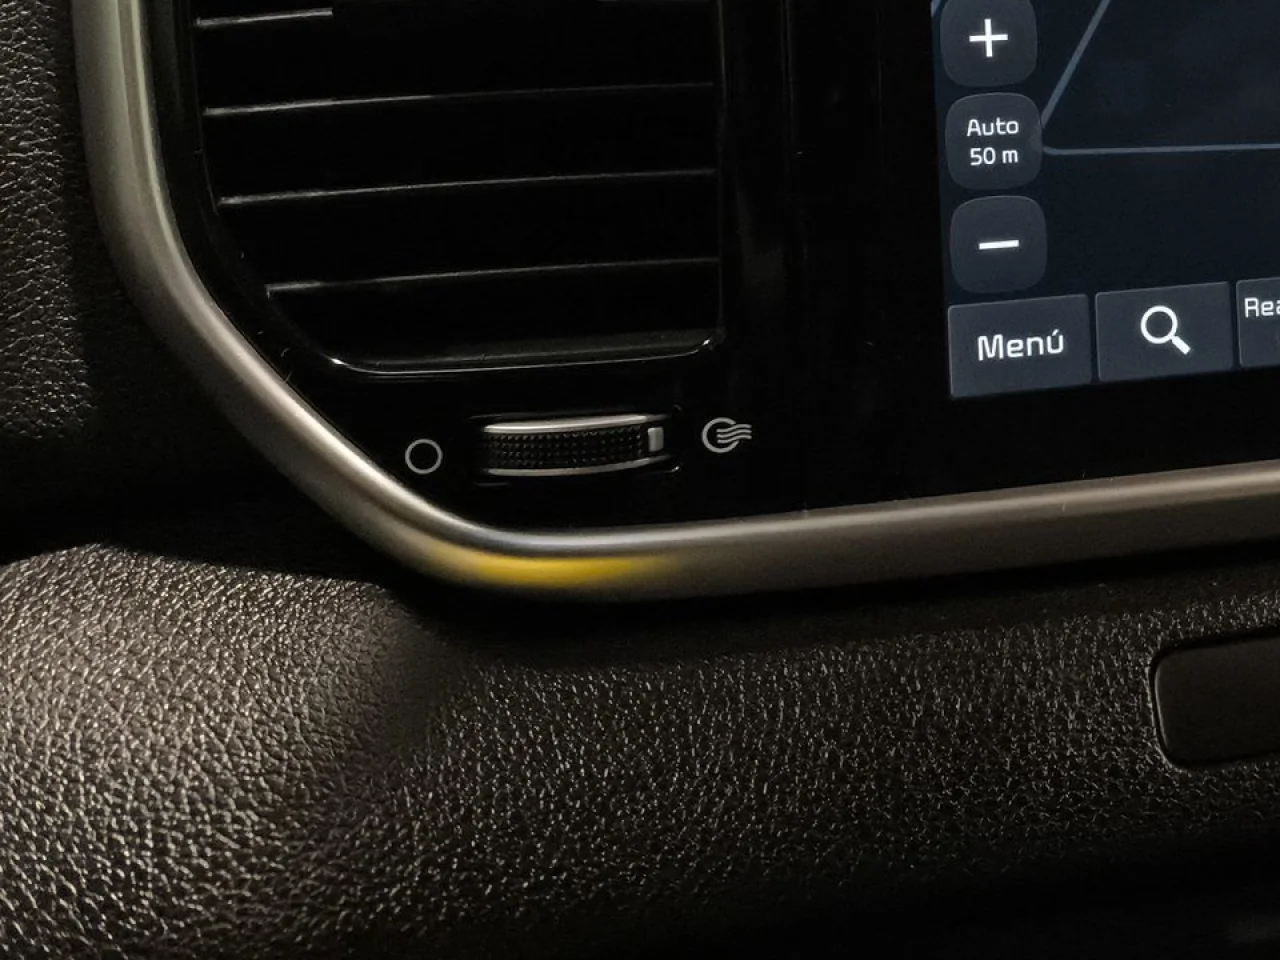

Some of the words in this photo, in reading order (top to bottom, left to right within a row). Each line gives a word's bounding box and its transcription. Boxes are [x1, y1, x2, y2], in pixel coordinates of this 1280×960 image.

[966, 116, 1020, 137] Auto
[969, 146, 997, 166] 50
[1002, 149, 1019, 164] m
[977, 328, 1064, 362] Menú
